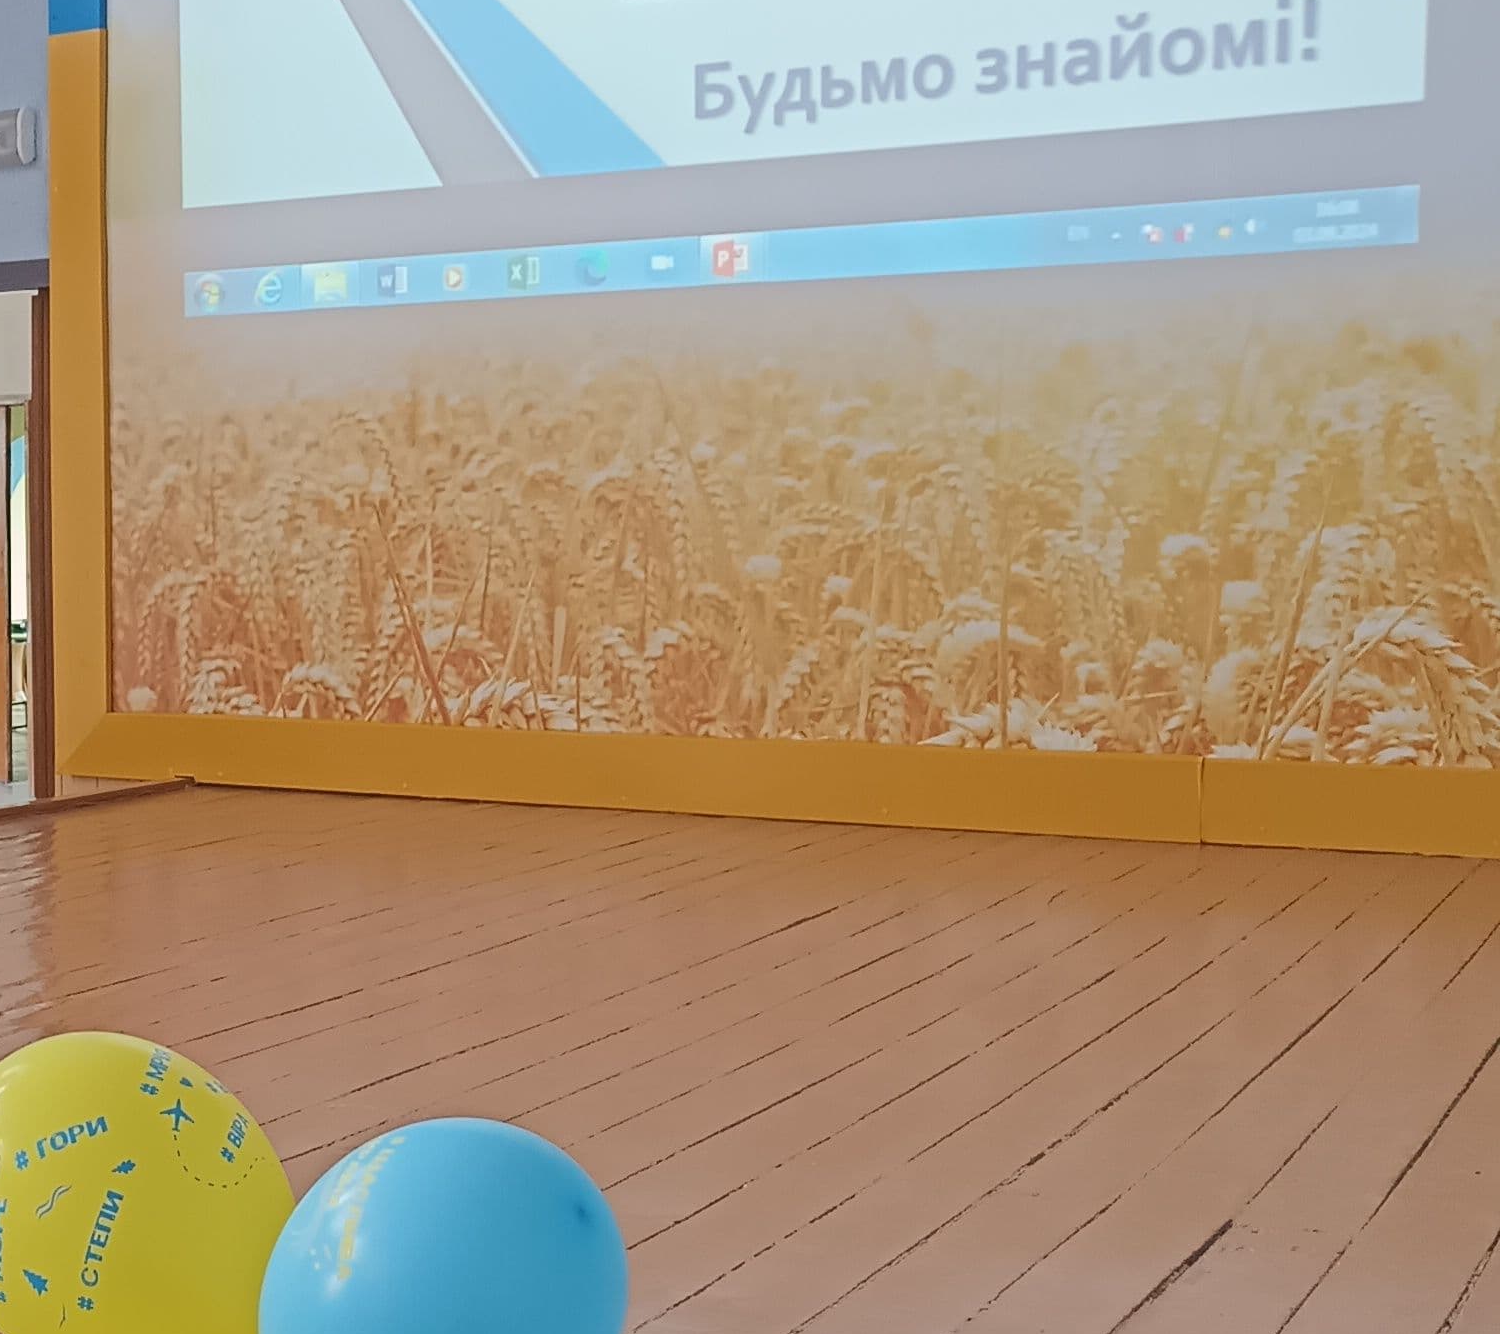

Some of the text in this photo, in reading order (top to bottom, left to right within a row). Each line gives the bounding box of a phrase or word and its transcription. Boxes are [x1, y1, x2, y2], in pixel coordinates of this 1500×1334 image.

[692, 52, 956, 135] Будьмо
[36, 1116, 109, 1159] ГОРИ
[81, 1189, 124, 1287] СТЕПИ
